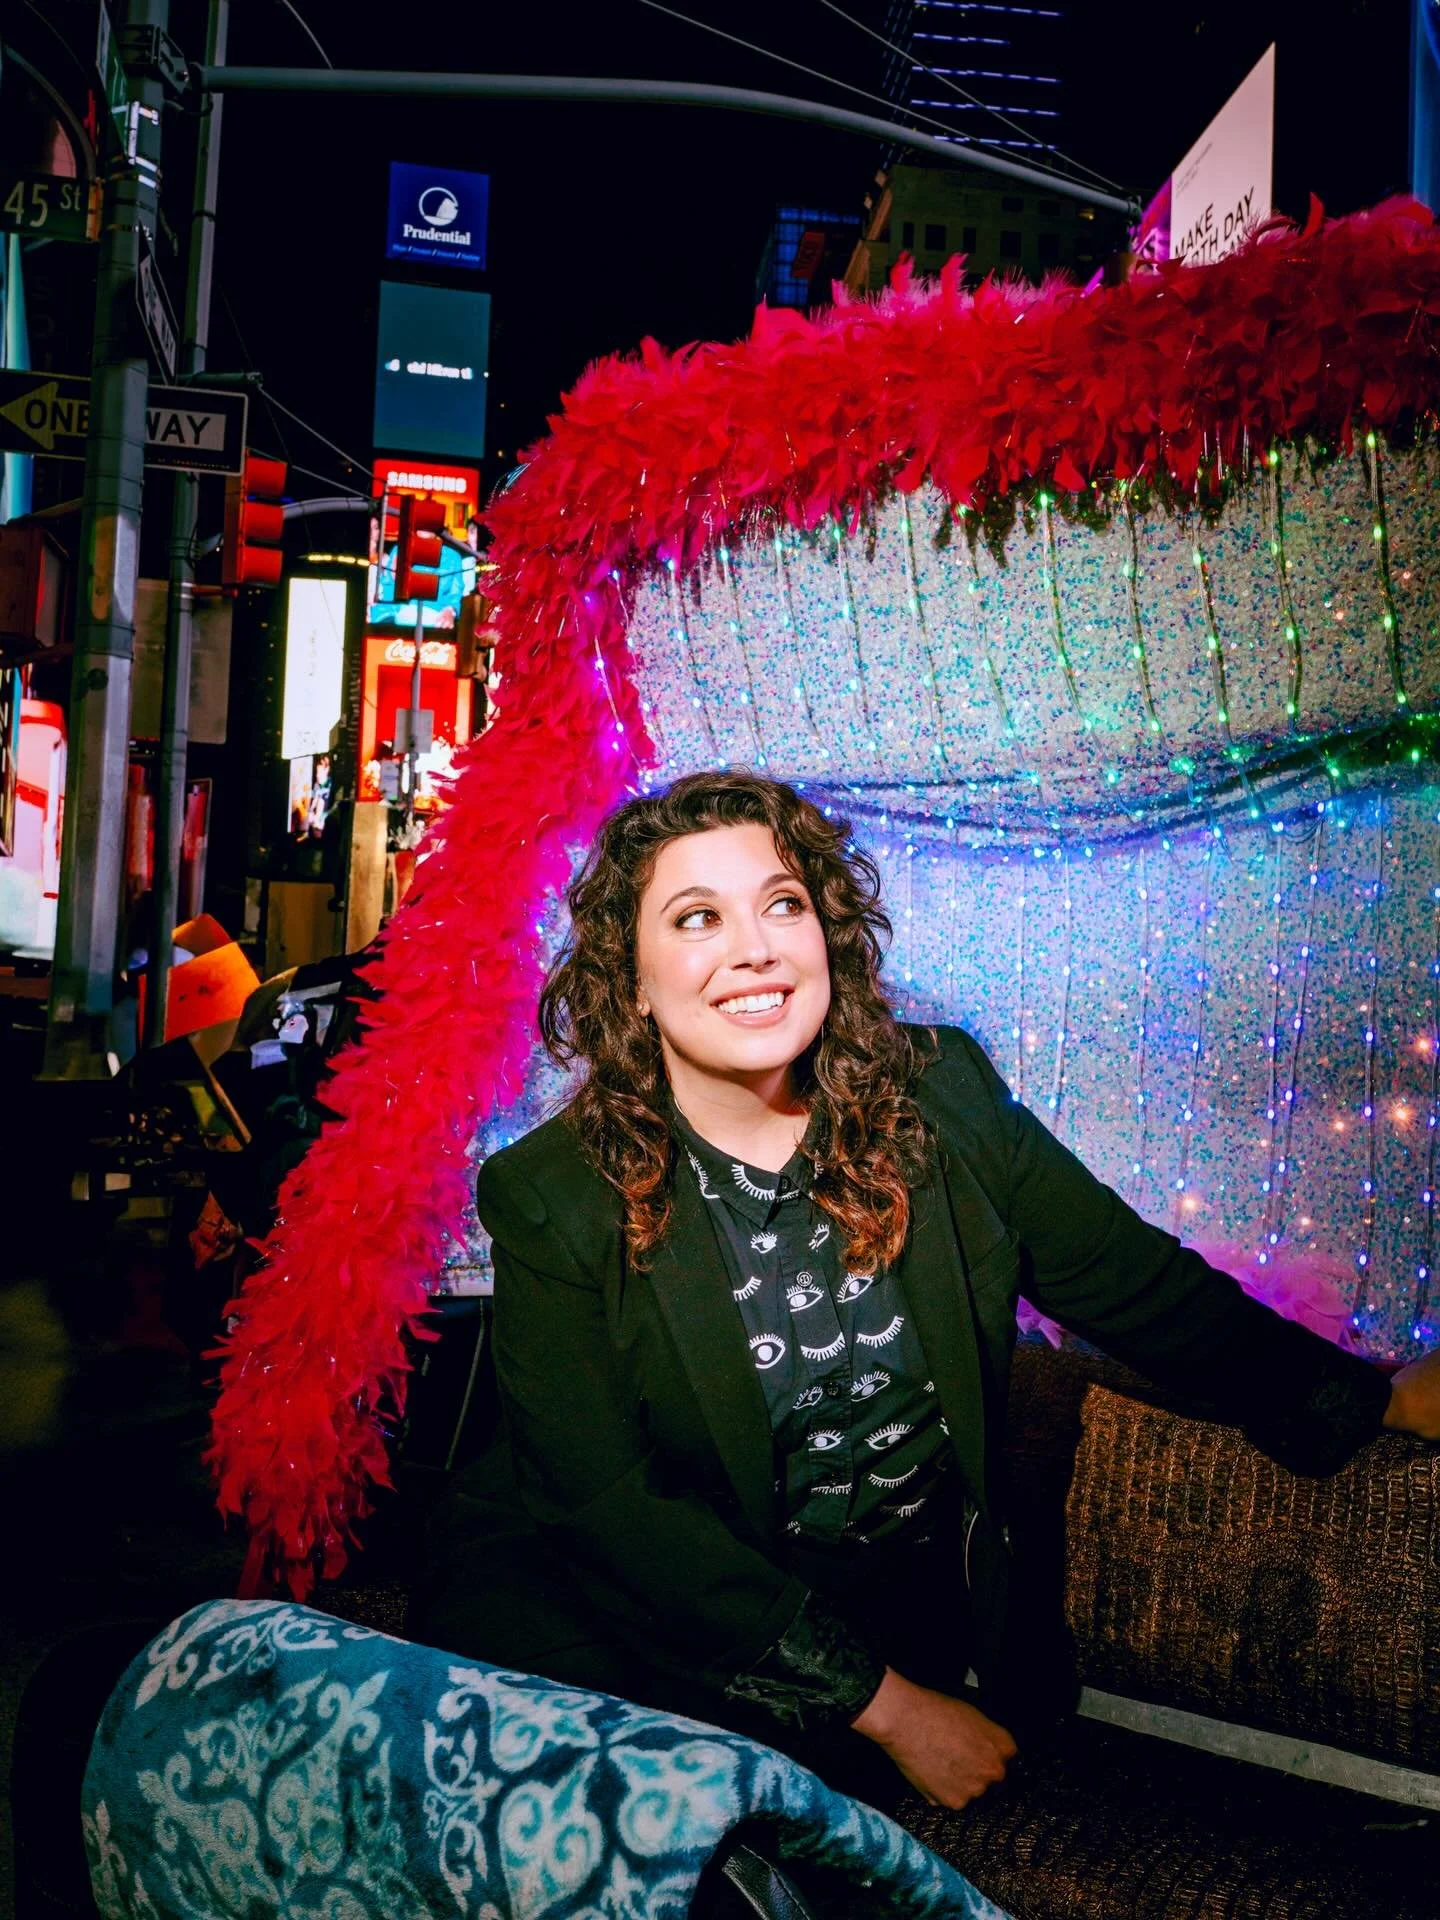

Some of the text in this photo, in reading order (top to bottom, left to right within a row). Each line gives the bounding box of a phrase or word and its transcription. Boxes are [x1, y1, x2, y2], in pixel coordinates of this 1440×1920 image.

[4, 181, 82, 228] 45 St
[1224, 185, 1255, 242] DAY
[402, 223, 471, 246] Prudential
[24, 398, 90, 434] ONE
